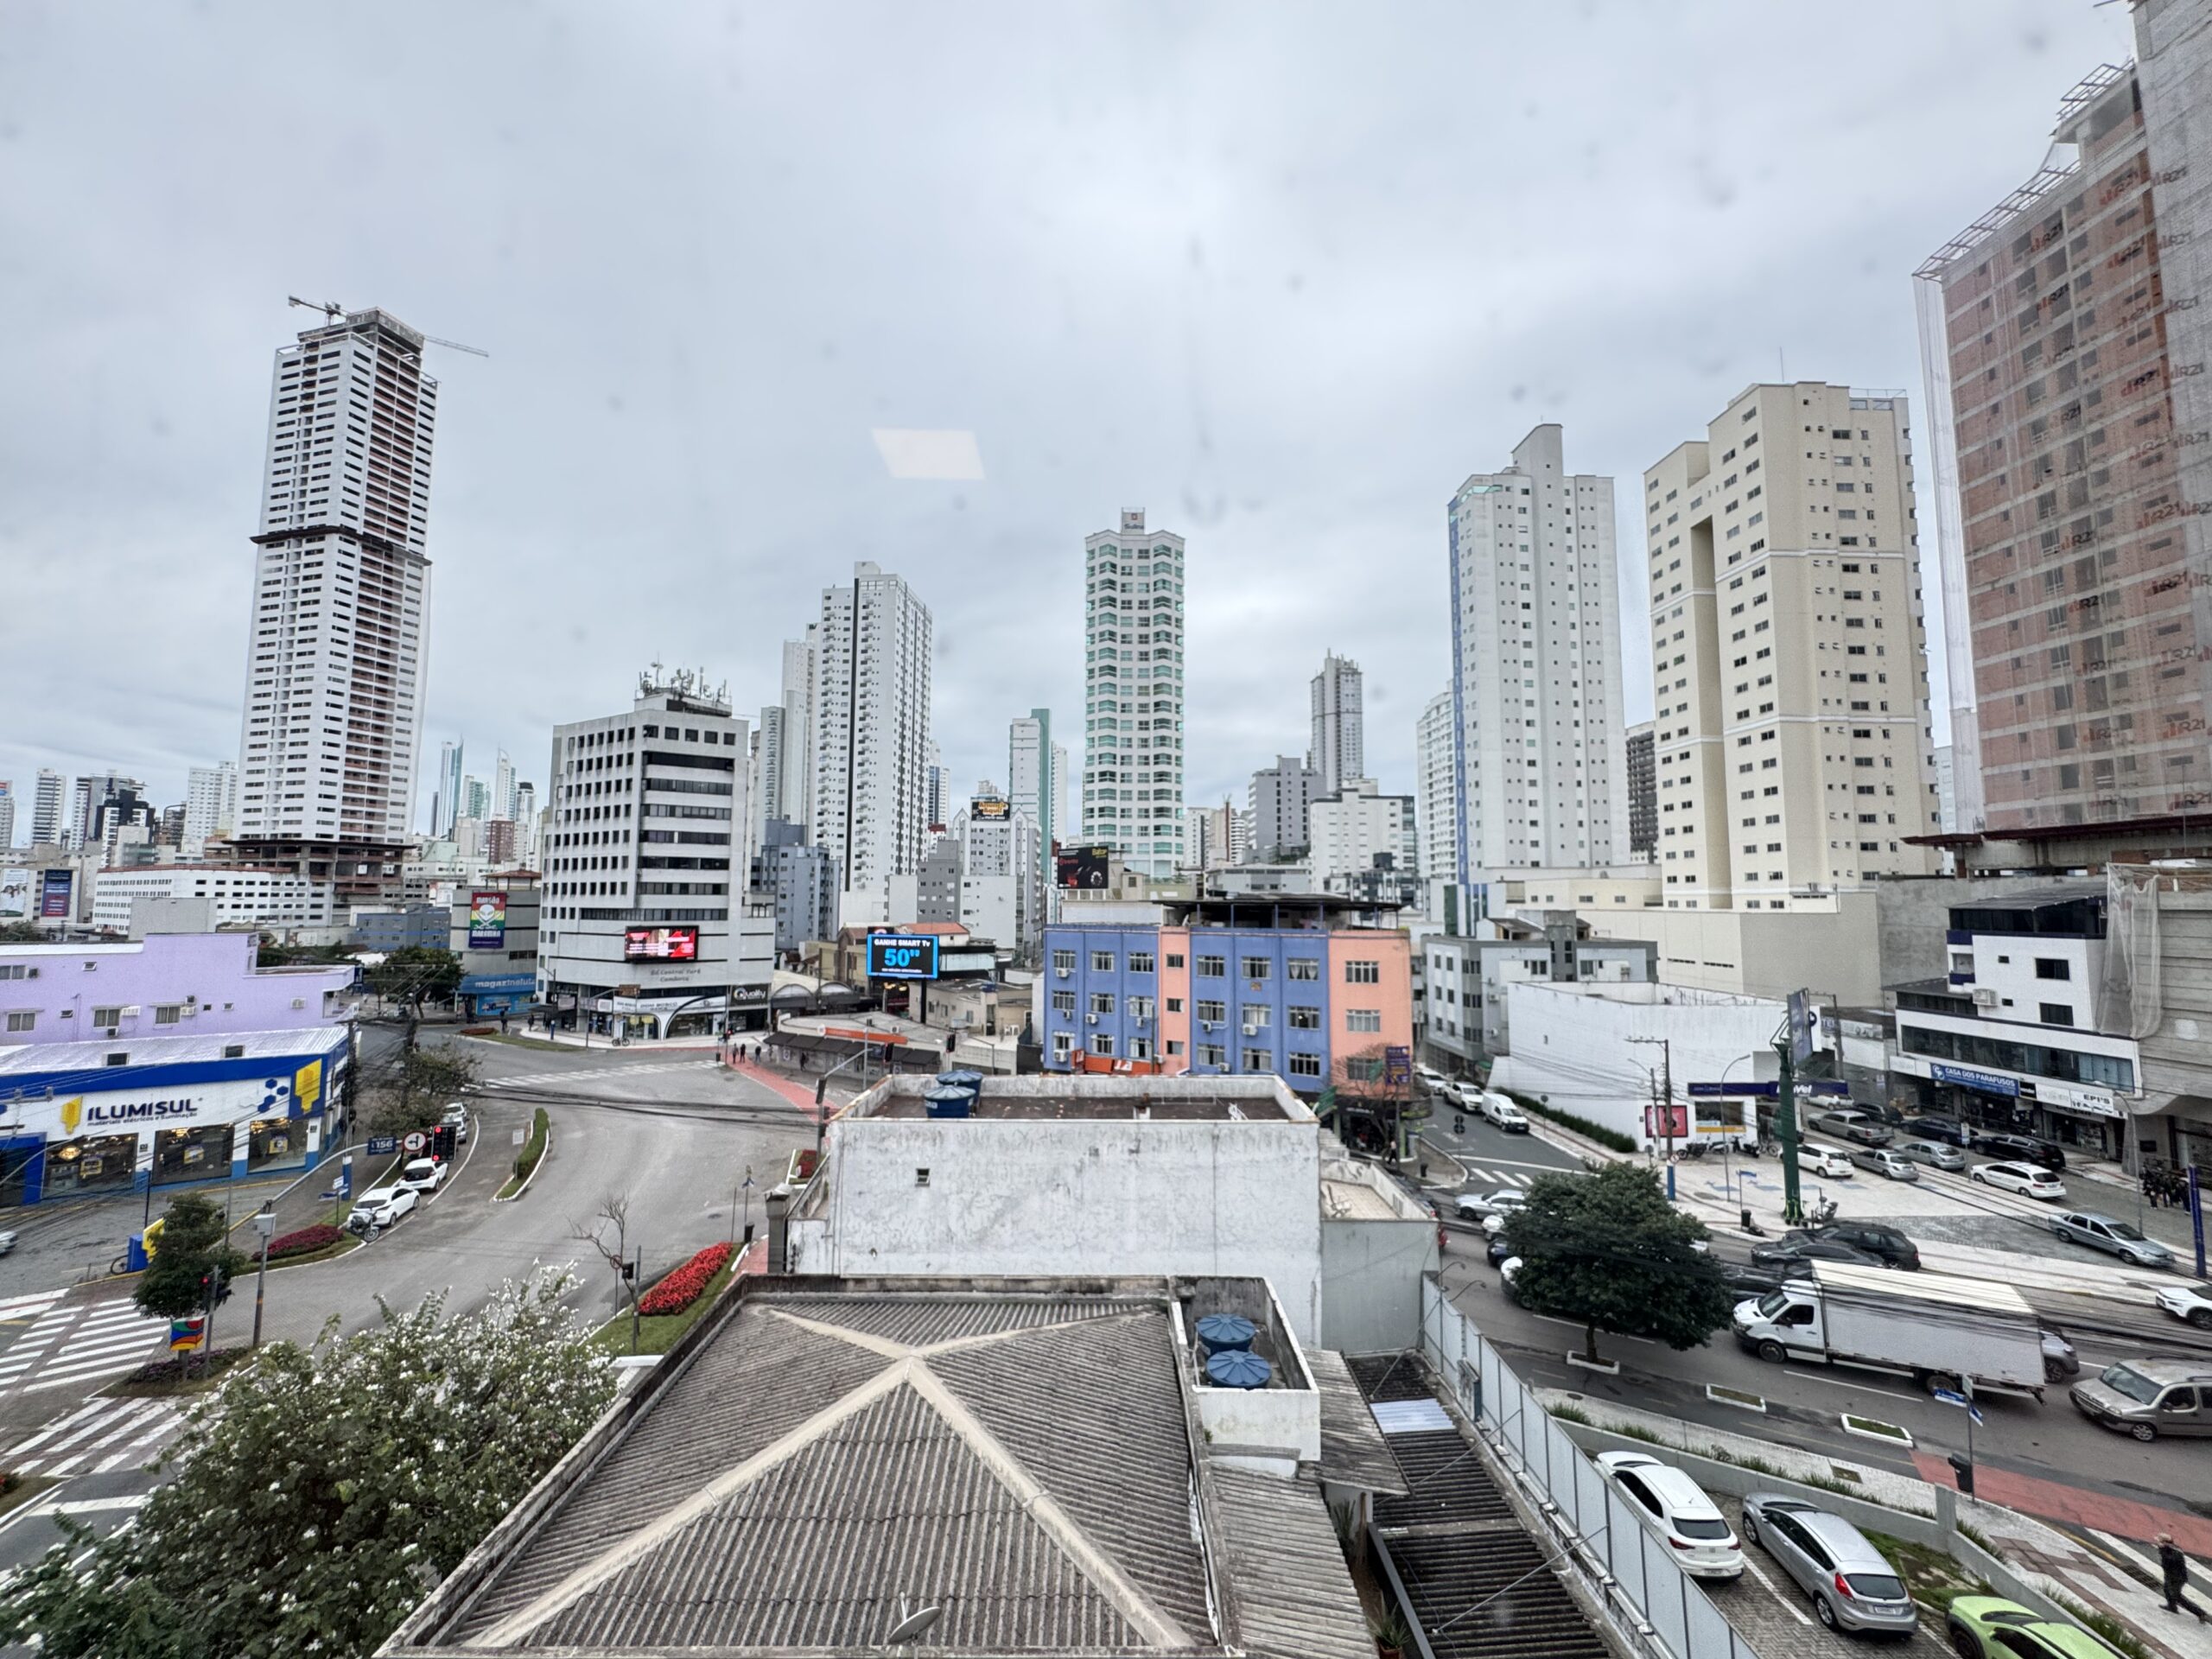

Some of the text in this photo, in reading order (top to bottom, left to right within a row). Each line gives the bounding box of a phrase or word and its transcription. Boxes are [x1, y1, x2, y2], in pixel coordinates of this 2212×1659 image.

[2184, 431, 2209, 445] R21
[1945, 1066, 1961, 1077] CASA
[1961, 1070, 1975, 1079] DOS
[1975, 1072, 2015, 1087] PARAFUSOS
[87, 1098, 199, 1122] ILUMISUL
[87, 1118, 122, 1127] materiais
[123, 1116, 155, 1124] elétricos
[161, 1111, 198, 1122] iluminação
